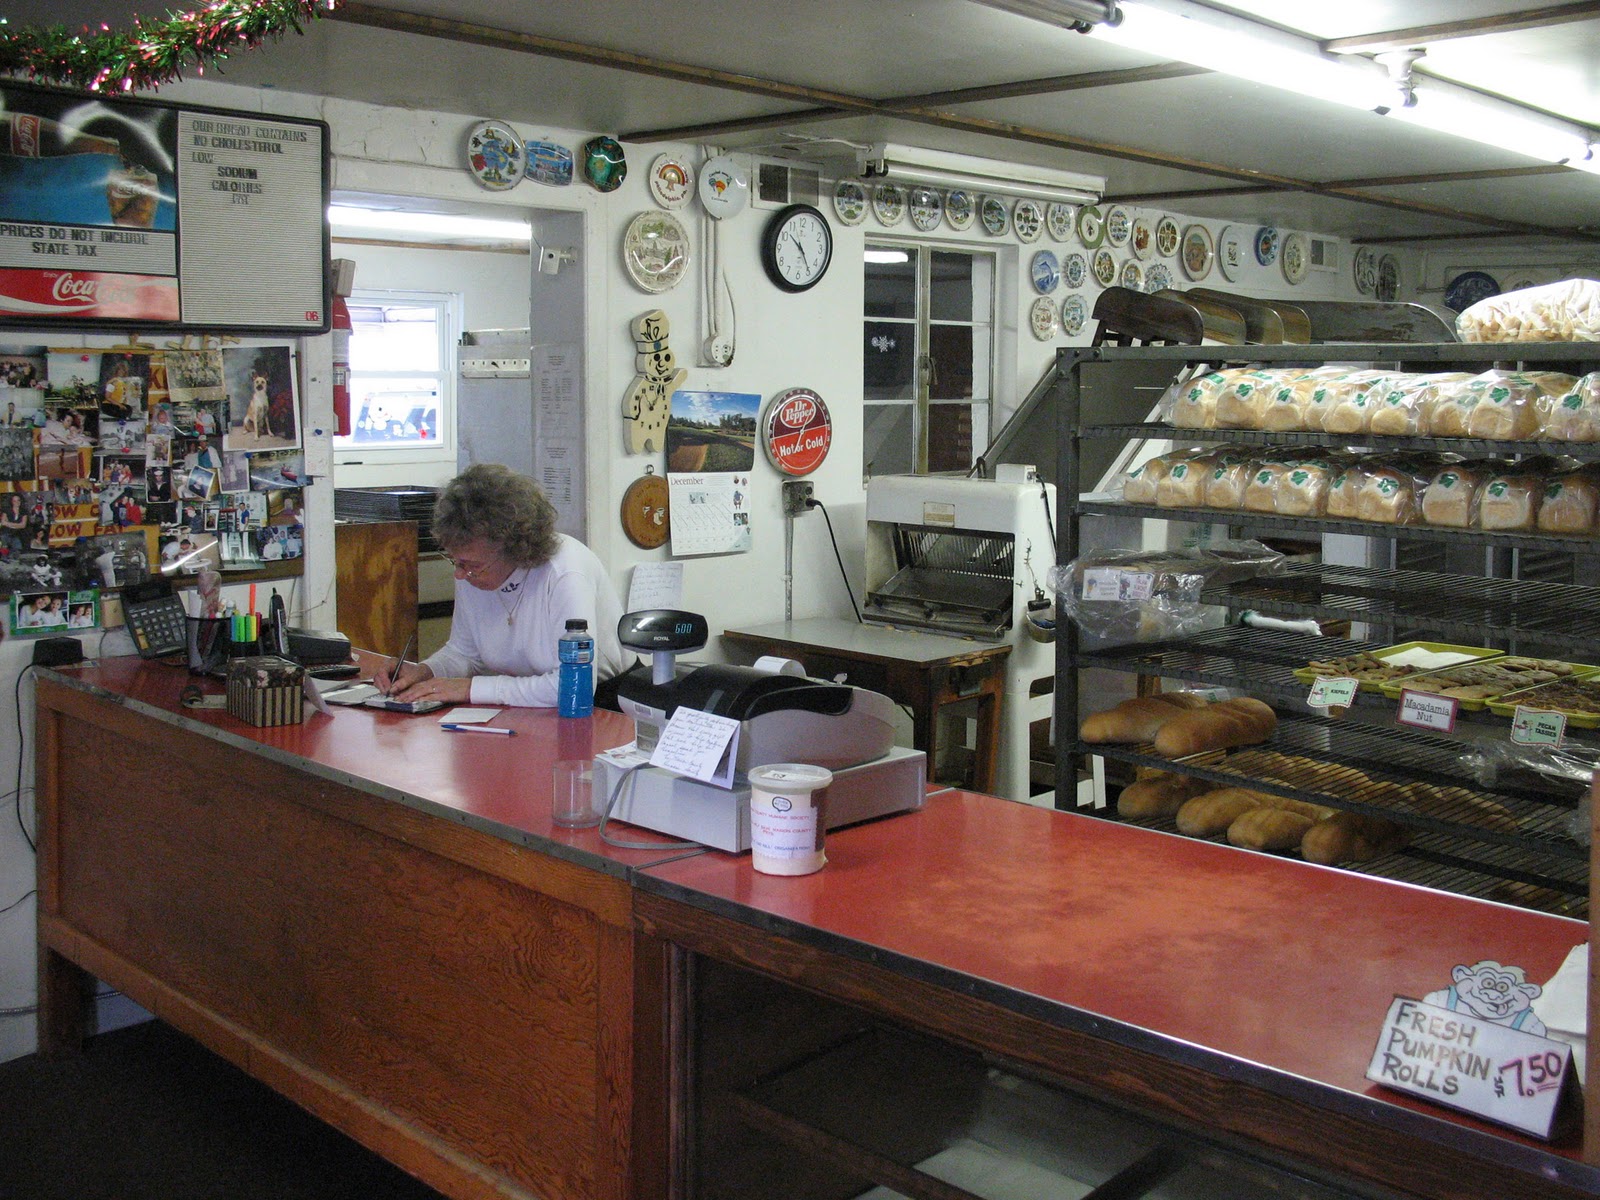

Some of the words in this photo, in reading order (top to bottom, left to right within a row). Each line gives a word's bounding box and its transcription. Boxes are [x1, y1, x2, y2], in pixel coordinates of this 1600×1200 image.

[193, 134, 207, 146] NO
[211, 136, 284, 154] CHOLESTEROL
[192, 152, 214, 163] LOW
[217, 165, 258, 180] SODIUM
[211, 180, 263, 194] CALORIES
[0, 224, 44, 239] PRICES
[50, 227, 66, 240] DO
[71, 229, 94, 242] NOT
[101, 230, 149, 245] INCLUDE
[32, 242, 69, 256] STATE
[75, 244, 98, 257] TAX
[794, 400, 808, 412] Dr
[785, 406, 814, 425] Pepper
[780, 443, 797, 457] Hot
[805, 435, 824, 450] Cold
[670, 476, 704, 486] December
[54, 504, 79, 519] OW
[675, 623, 692, 634] 600
[1404, 698, 1451, 717] Macadamia
[1416, 711, 1434, 723] Nut
[1395, 1001, 1477, 1048] FRESH
[1386, 1026, 1491, 1081] PUMPKIN
[1381, 1051, 1459, 1096] ROLLS
[1493, 1051, 1562, 1099] $7.50
